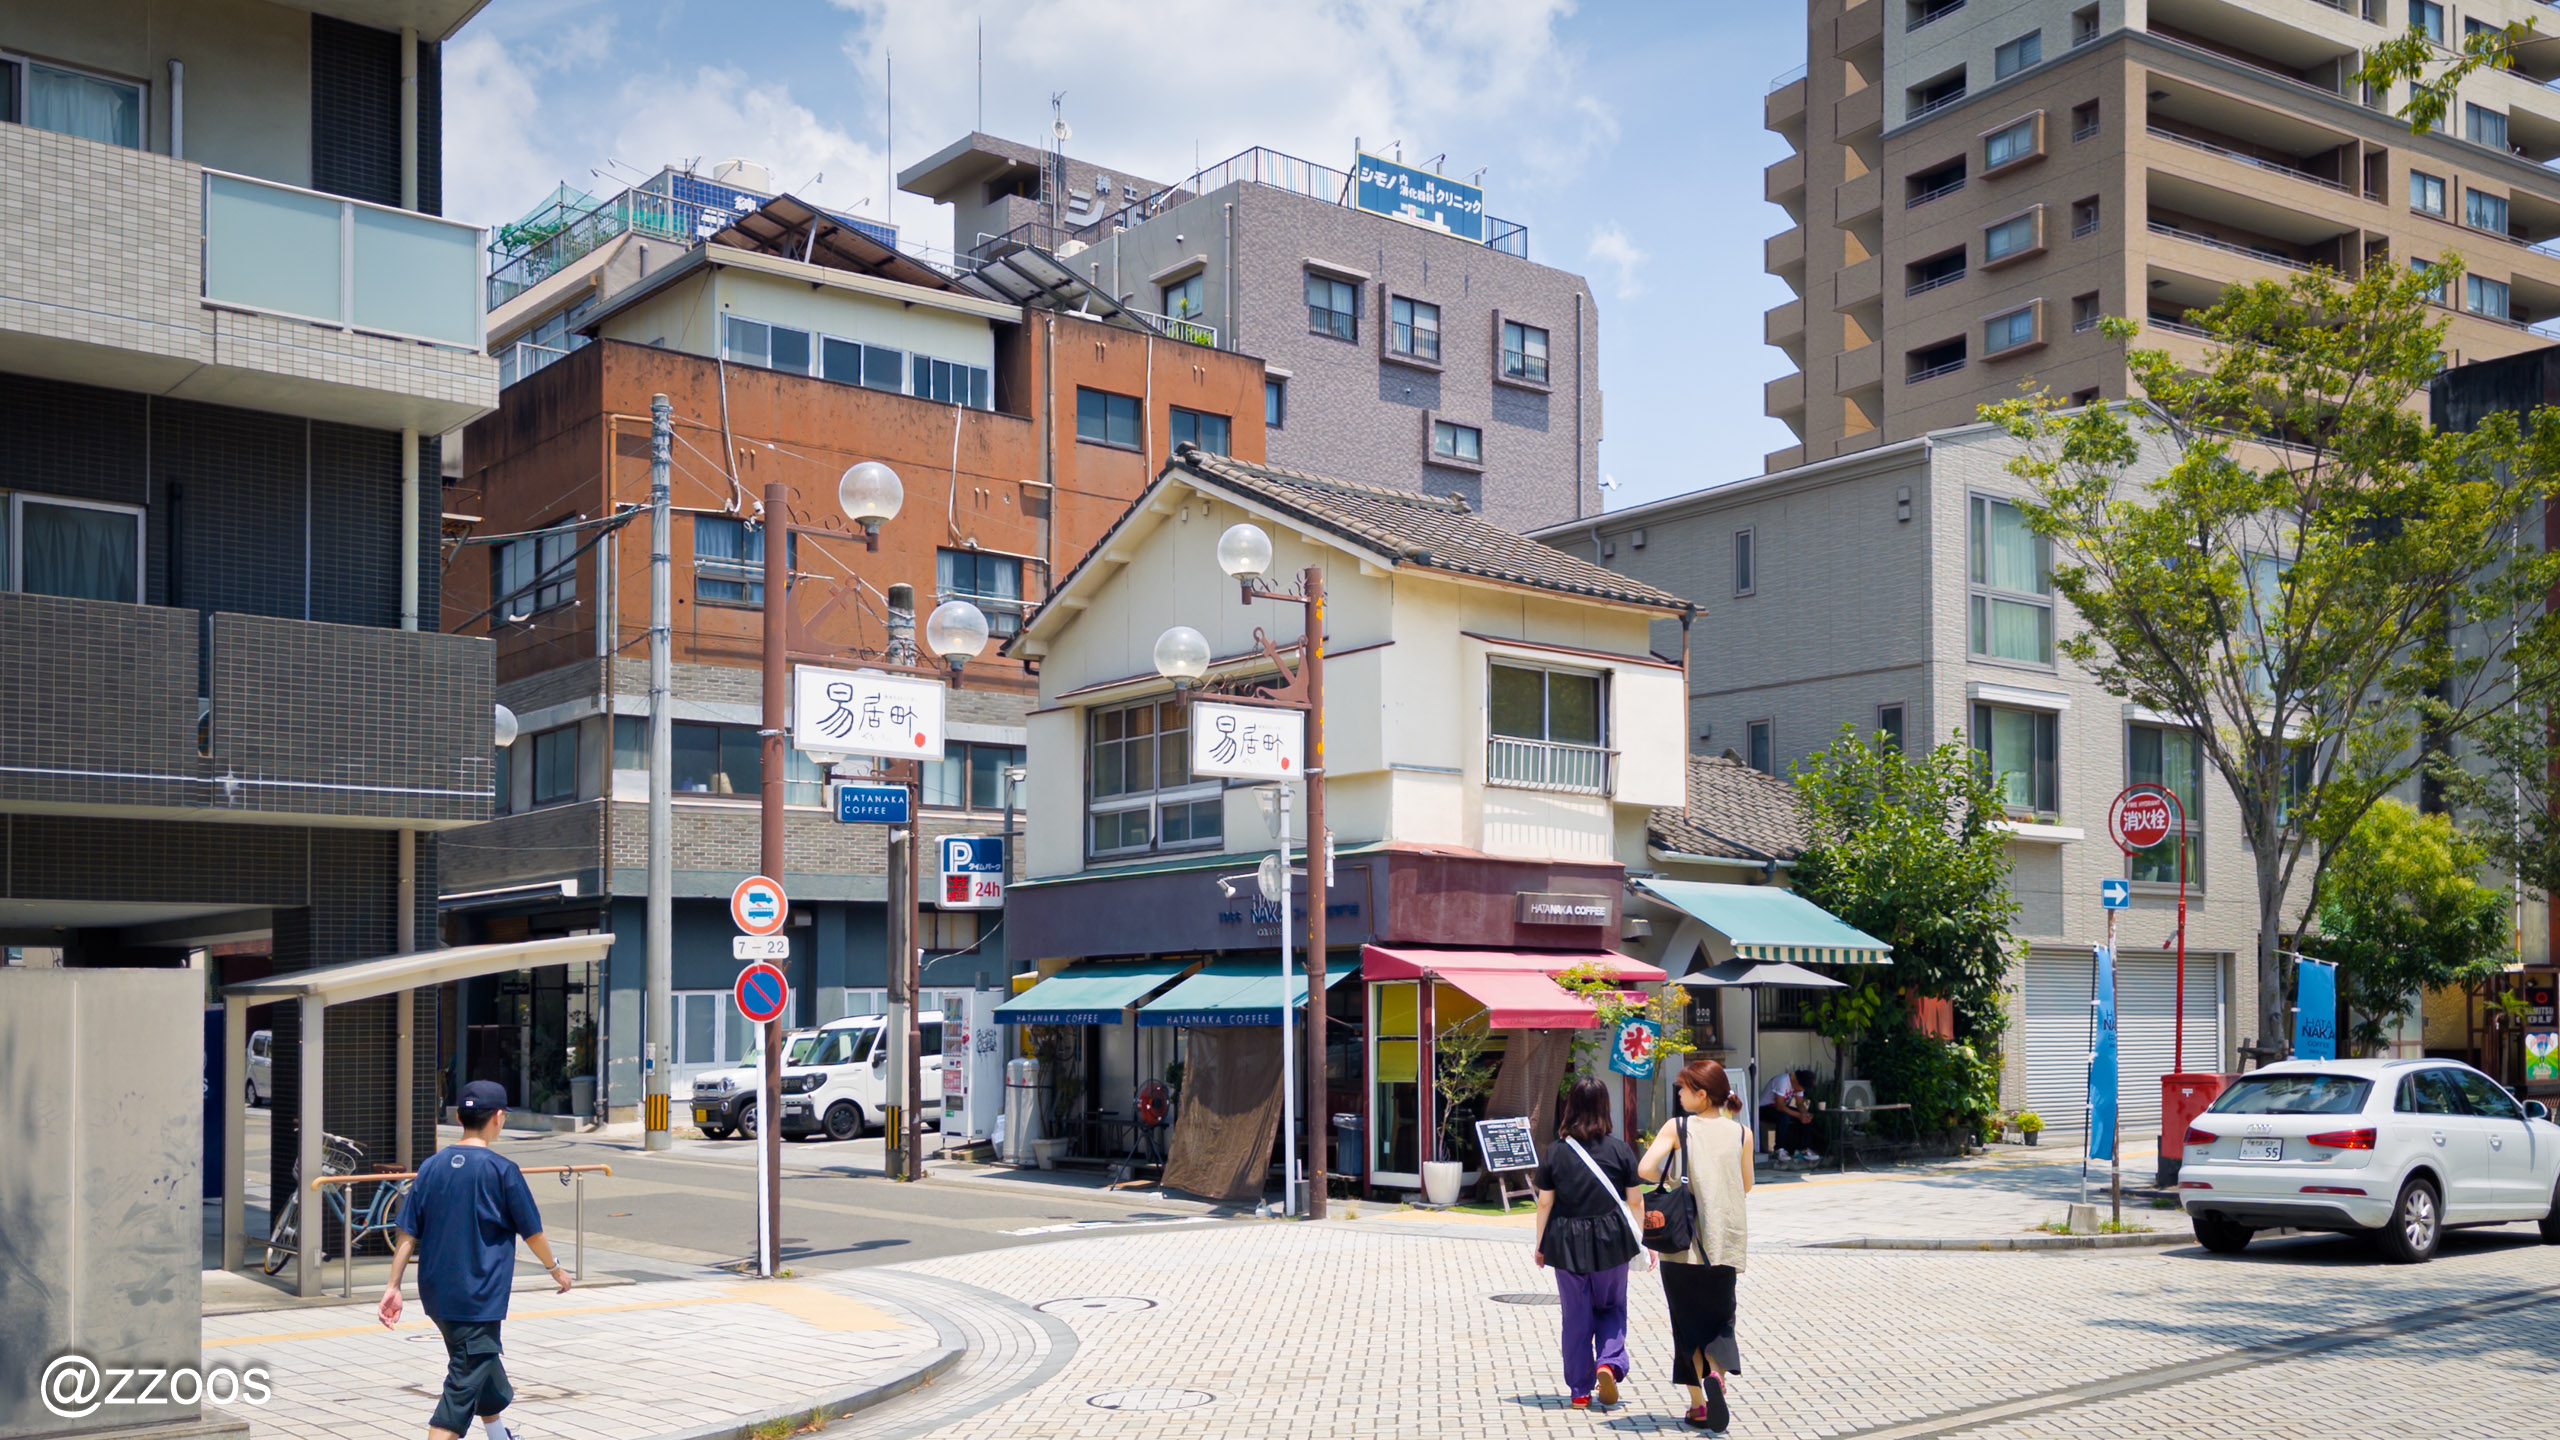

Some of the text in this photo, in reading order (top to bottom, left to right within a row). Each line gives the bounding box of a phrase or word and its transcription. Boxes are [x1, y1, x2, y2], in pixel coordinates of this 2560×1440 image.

[1360, 167, 1396, 189] シモノ
[1436, 189, 1481, 214] クリニック
[844, 794, 905, 804] HATANAKA
[844, 806, 887, 815] COFFEE
[2123, 808, 2167, 832] 消火栓
[968, 862, 1001, 871] タイムパーク
[946, 875, 969, 902] 満
[975, 881, 1000, 897] 24h
[1531, 903, 1606, 916] HATANAKA COFFEE
[1016, 1013, 1099, 1023] HATANAKA COFFEE
[1166, 1014, 1270, 1025] HATANAKA COFFEE
[2305, 1017, 2332, 1030] HATA
[2302, 1026, 2334, 1039] NAKA
[1624, 1026, 1653, 1060] 氷
[2265, 1147, 2279, 1158] 55
